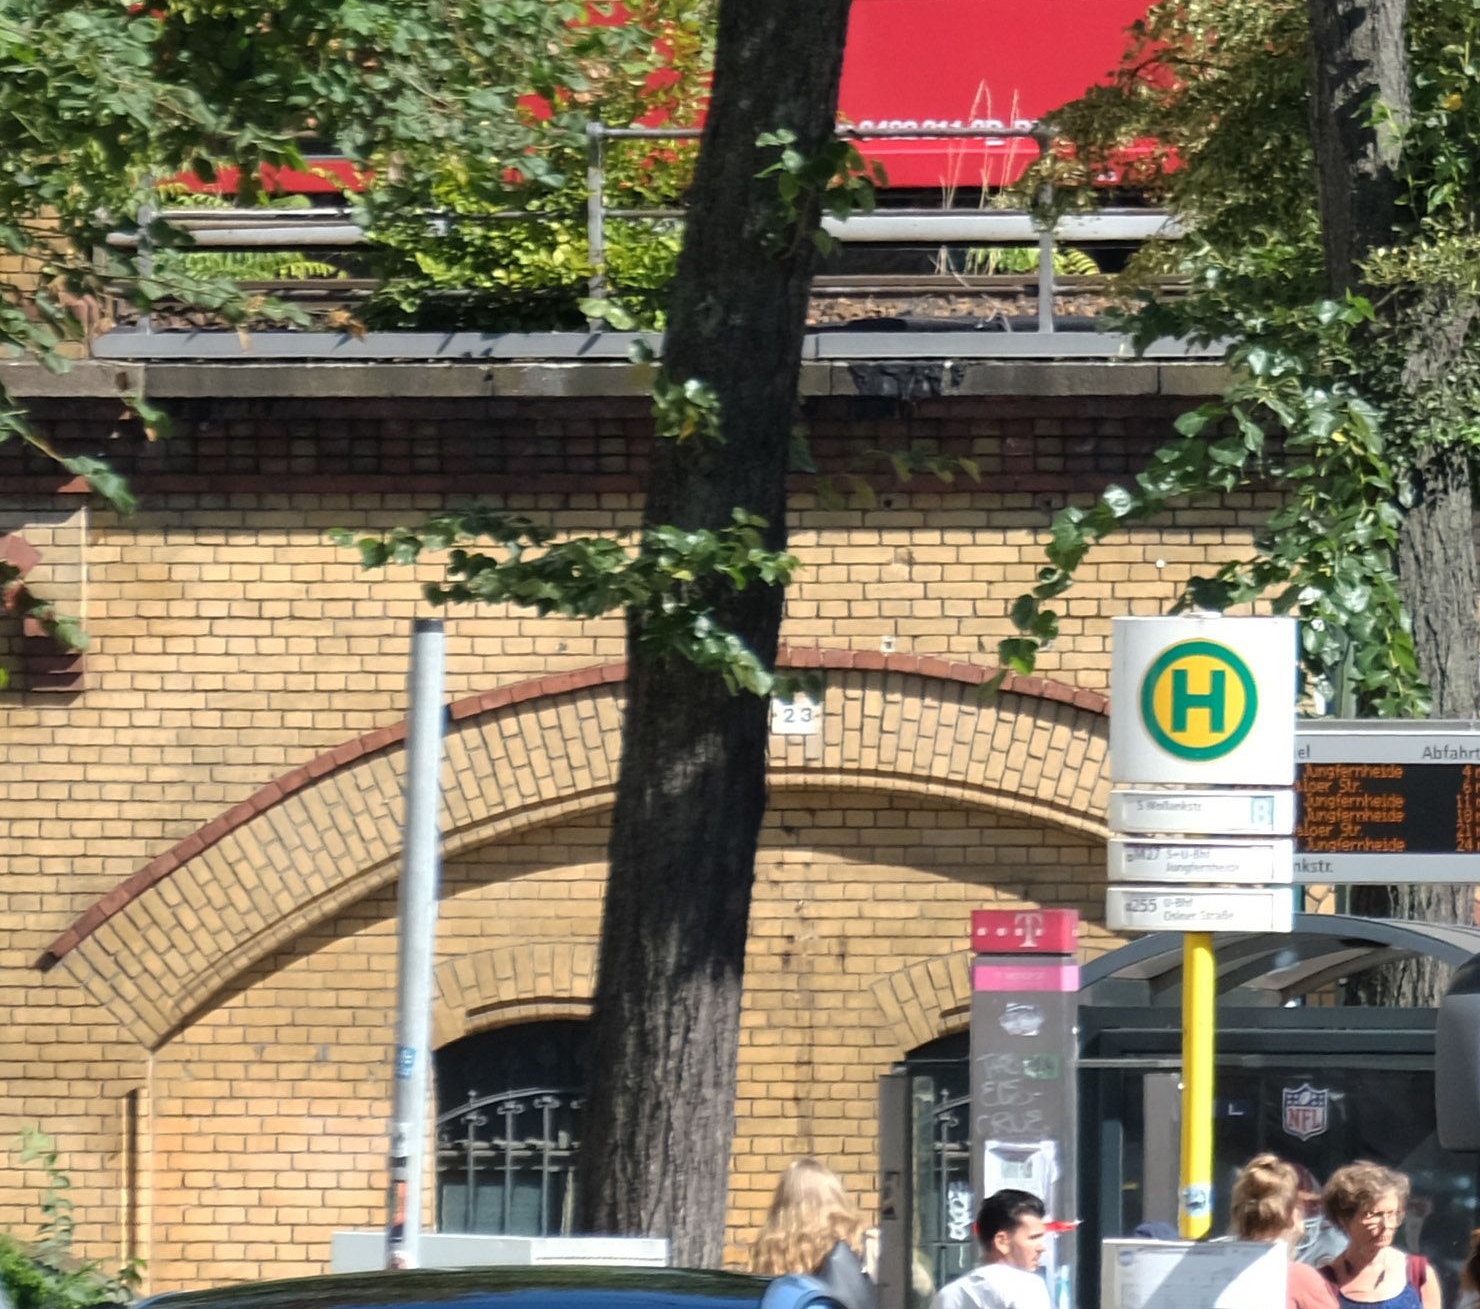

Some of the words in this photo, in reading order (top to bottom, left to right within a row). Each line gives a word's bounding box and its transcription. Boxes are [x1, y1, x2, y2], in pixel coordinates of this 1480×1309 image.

[1173, 670, 1225, 732] H
[784, 707, 812, 723] 23
[1422, 746, 1480, 760] Abfahrt
[1305, 765, 1403, 779] Jungfernheide
[1462, 765, 1472, 777] 4
[1304, 794, 1405, 808] Jungfernheide
[1305, 809, 1405, 822] Jungfernheide
[1306, 837, 1406, 851] Jungfernheide
[1456, 838, 1473, 851] 24
[1014, 914, 1044, 947] T
[1286, 1107, 1326, 1132] NFL
